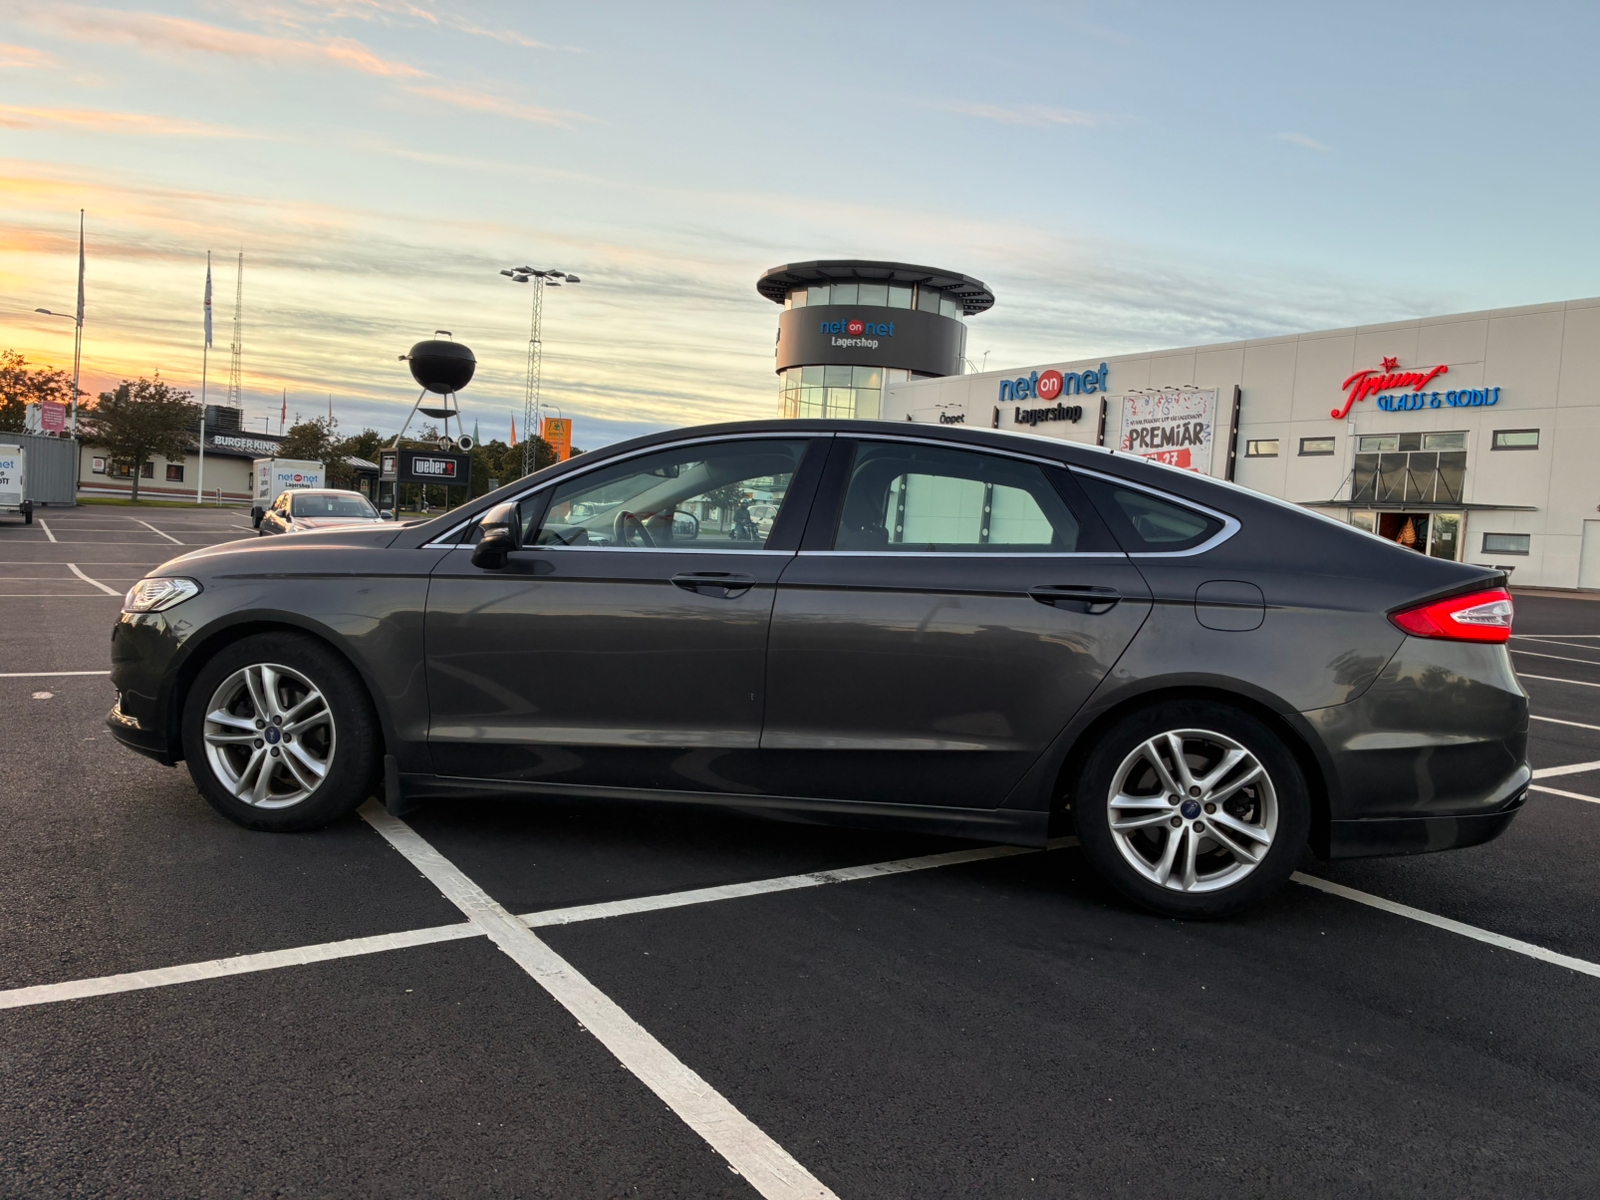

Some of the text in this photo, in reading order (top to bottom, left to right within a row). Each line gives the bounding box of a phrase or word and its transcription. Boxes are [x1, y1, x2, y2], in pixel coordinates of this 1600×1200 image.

[831, 336, 878, 349] Lagershop
[1331, 364, 1448, 419] Triumf
[1376, 387, 1500, 411] GLASS & GODIS
[940, 411, 965, 424] Öppet
[1014, 402, 1082, 426] Lagershop
[416, 459, 445, 473] weber
